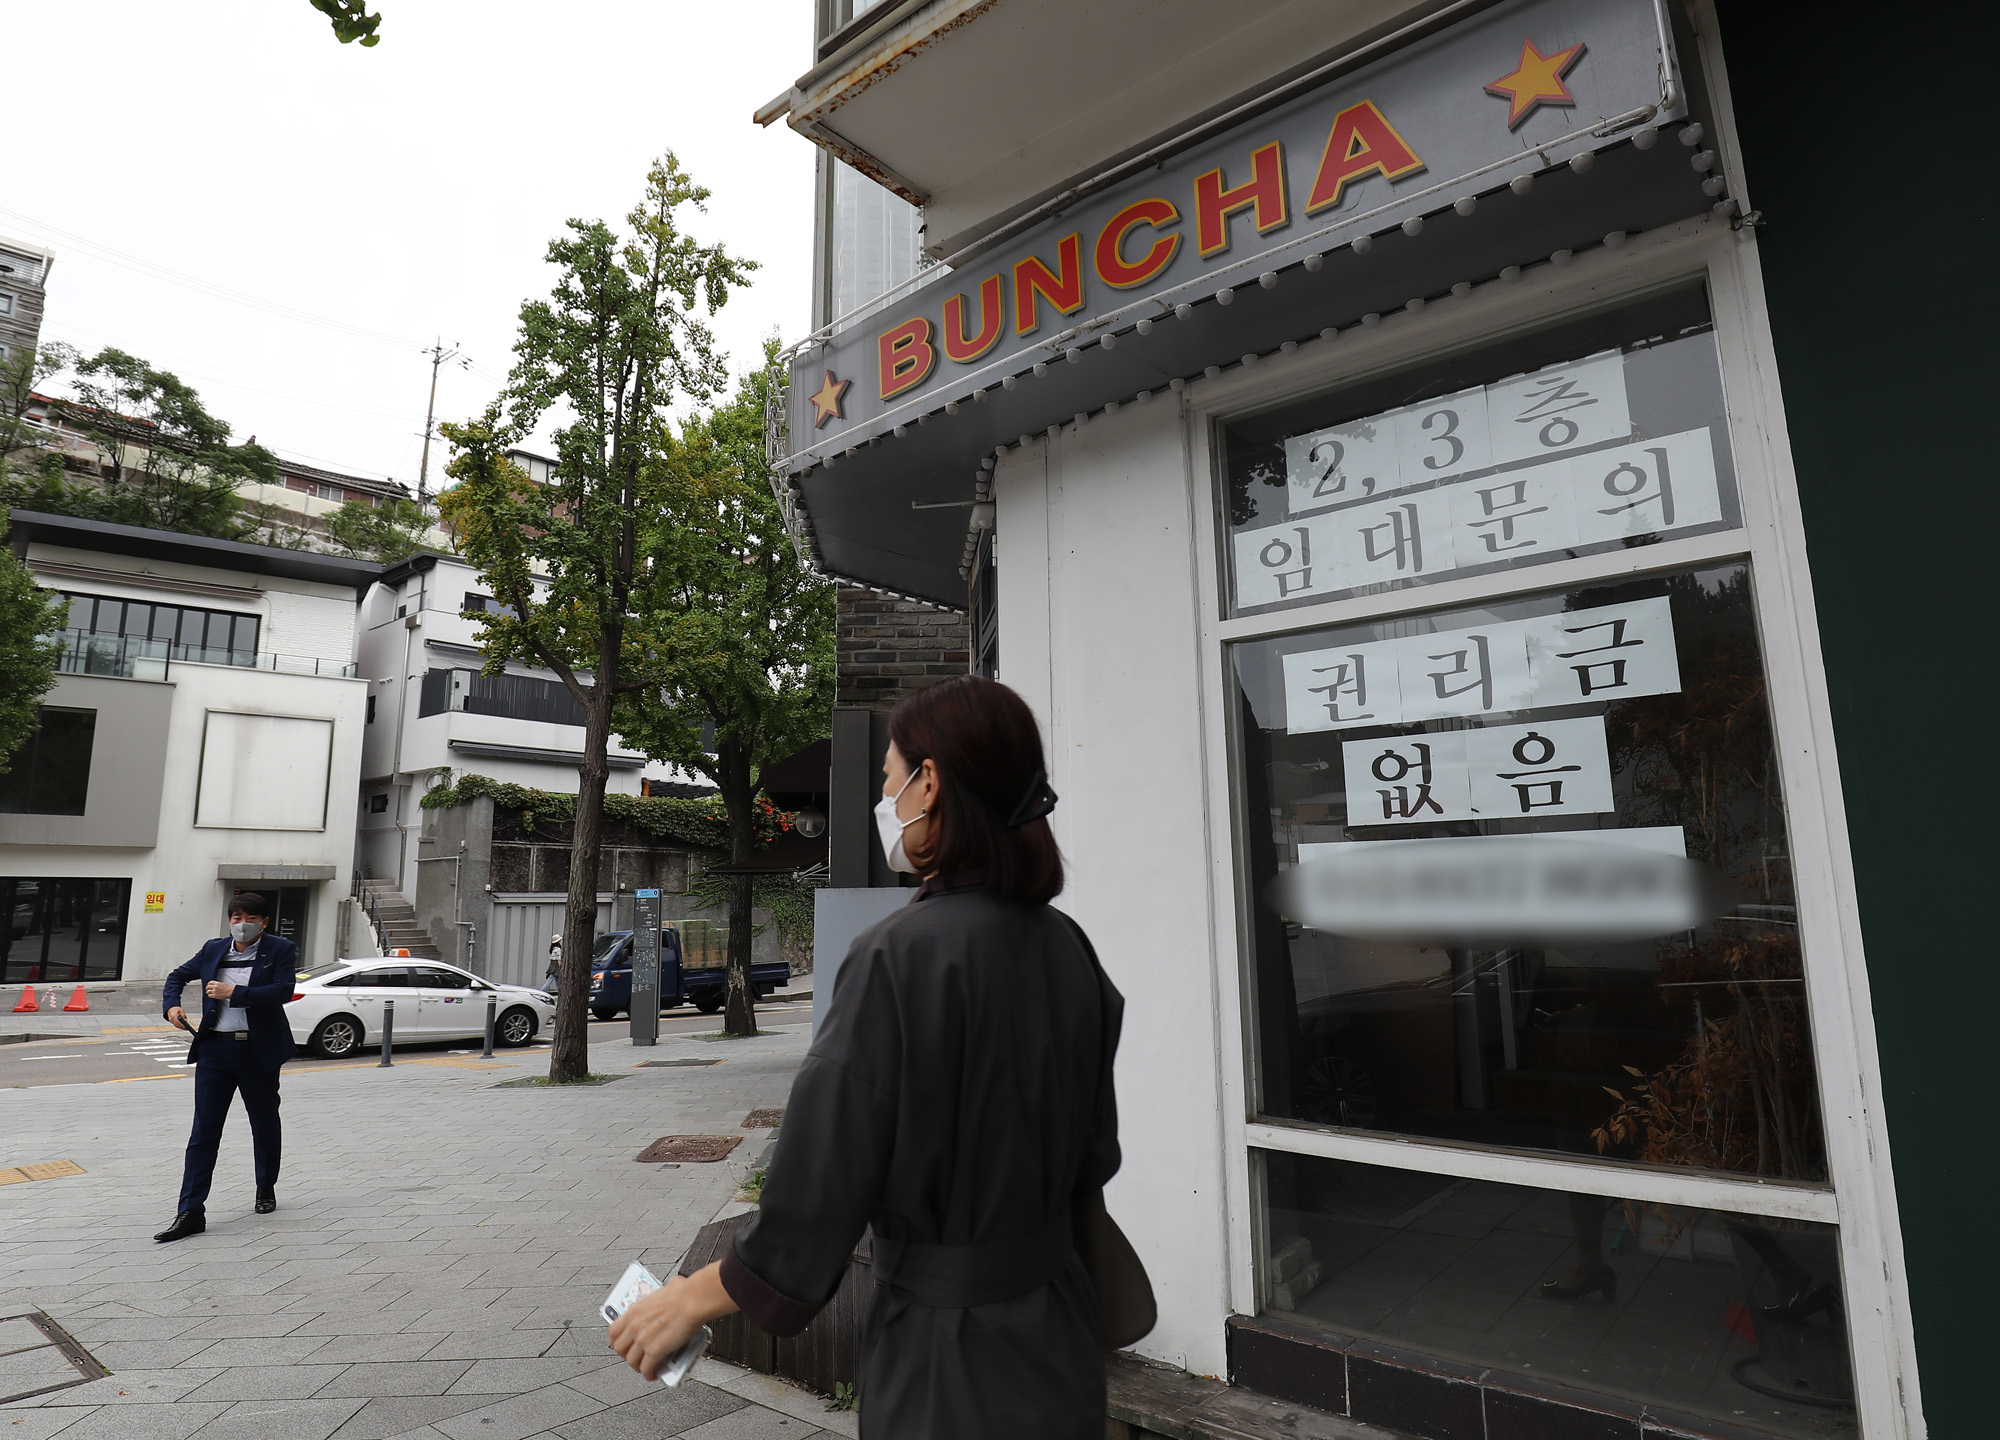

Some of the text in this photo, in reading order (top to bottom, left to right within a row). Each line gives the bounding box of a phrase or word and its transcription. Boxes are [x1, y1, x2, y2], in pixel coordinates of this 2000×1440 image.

[878, 99, 1428, 401] BUNCHA
[1307, 618, 1645, 723] 권리금
[1371, 731, 1582, 819] 없음
[146, 894, 165, 904] 임대
